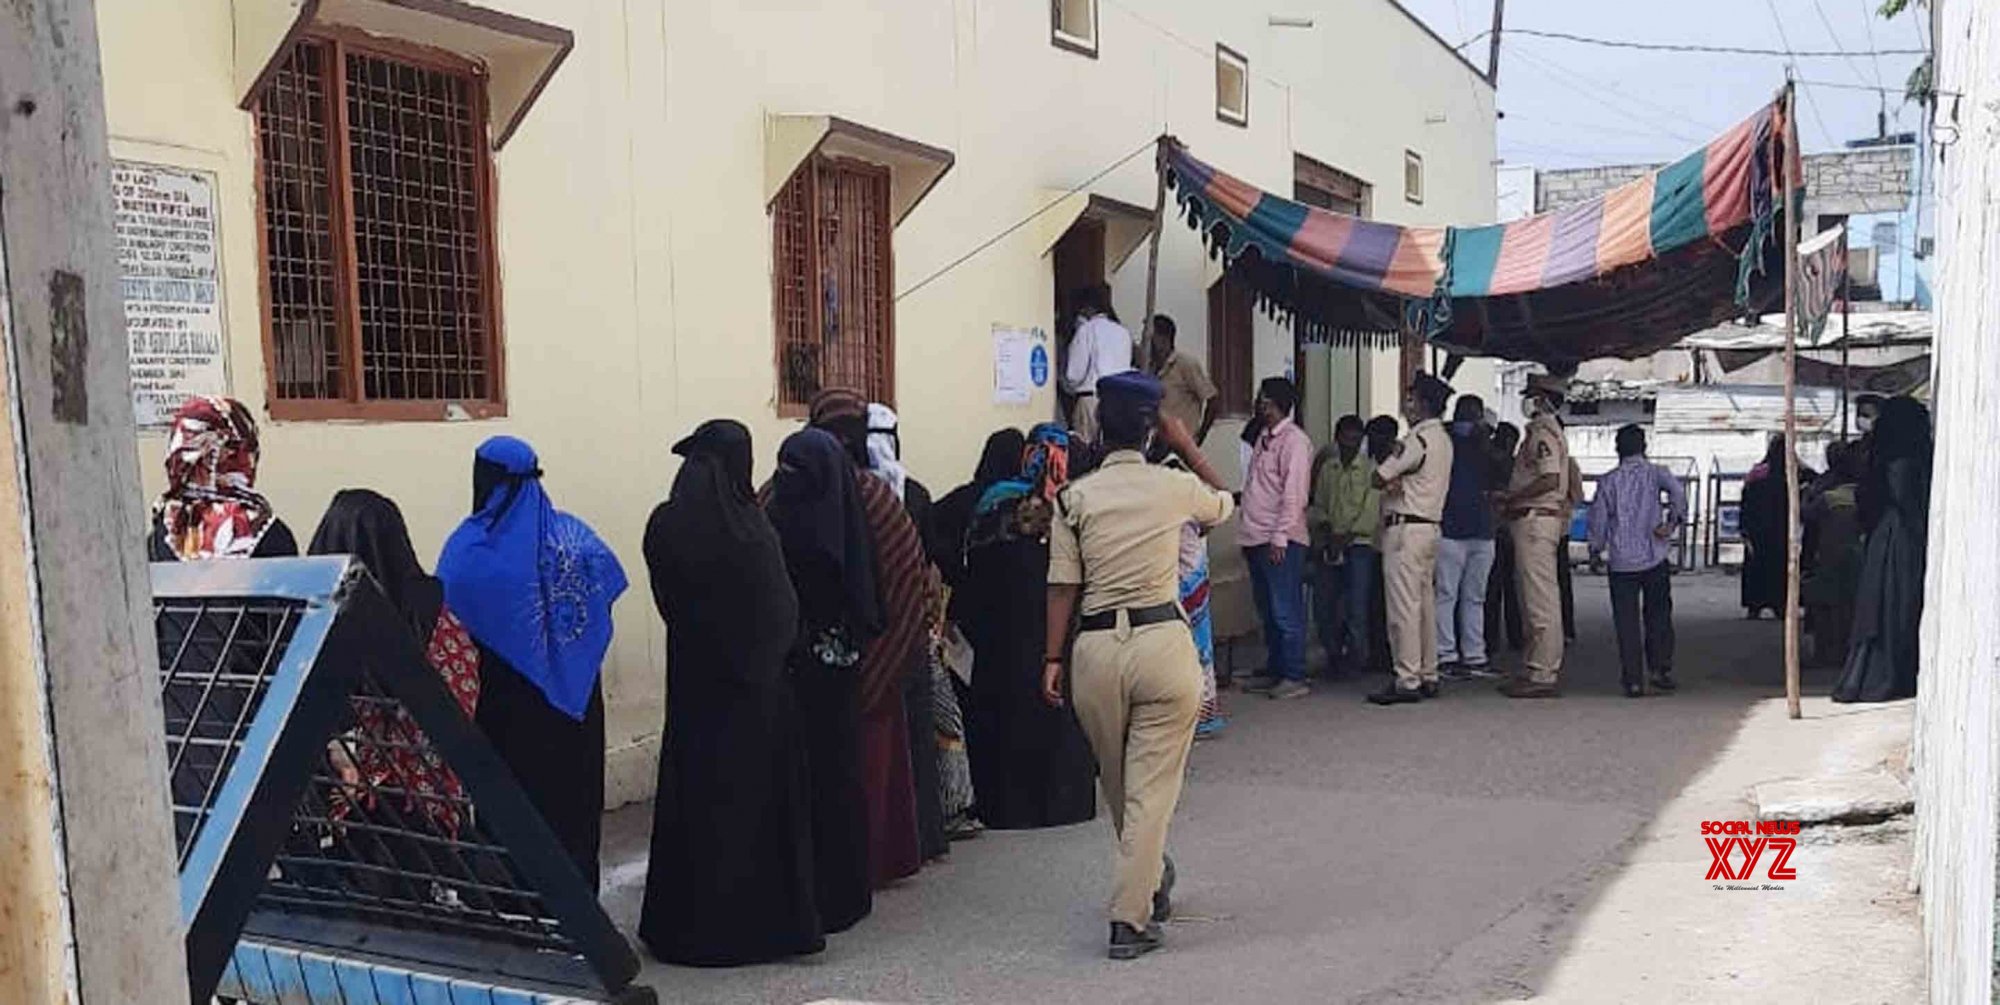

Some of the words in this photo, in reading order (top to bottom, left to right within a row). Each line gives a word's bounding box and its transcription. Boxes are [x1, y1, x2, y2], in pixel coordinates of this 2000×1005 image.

[122, 200, 158, 214] WATER
[160, 202, 183, 216] PIPE
[186, 205, 208, 220] LINE
